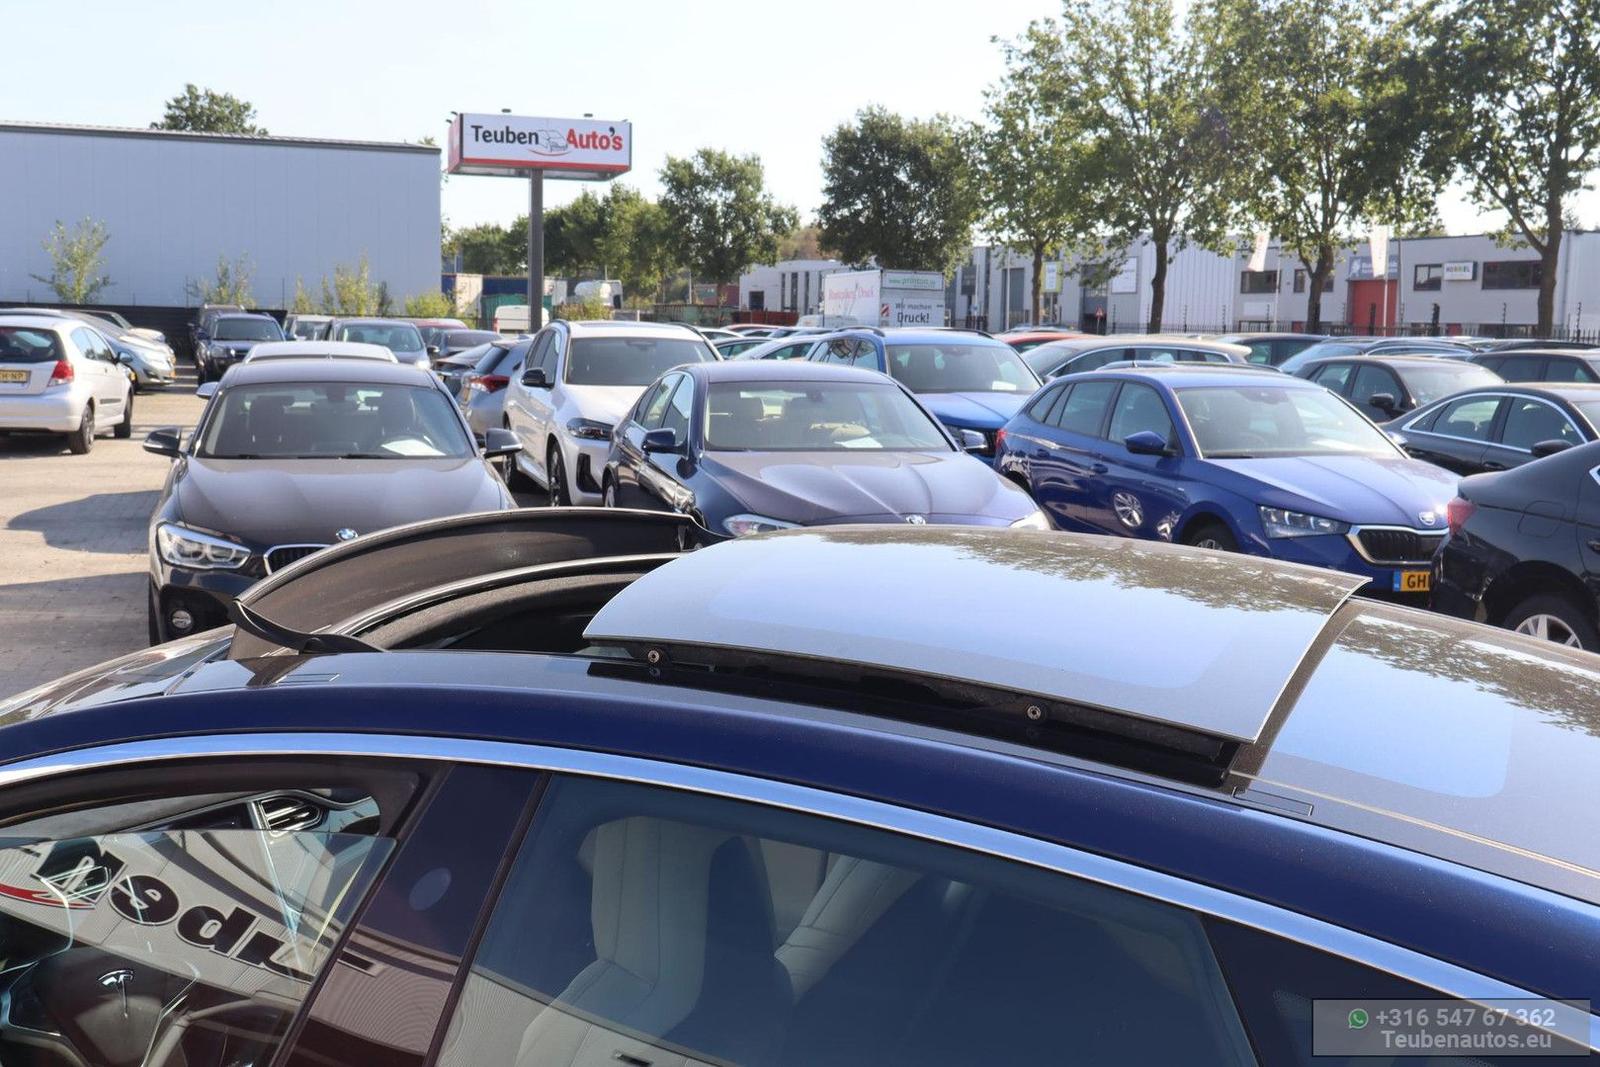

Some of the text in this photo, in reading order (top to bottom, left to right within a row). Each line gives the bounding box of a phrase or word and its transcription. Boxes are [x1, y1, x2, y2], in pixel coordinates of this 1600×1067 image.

[471, 125, 623, 150] Teuben Auto's
[897, 312, 930, 324] Druck!
[1407, 574, 1427, 589] GH
